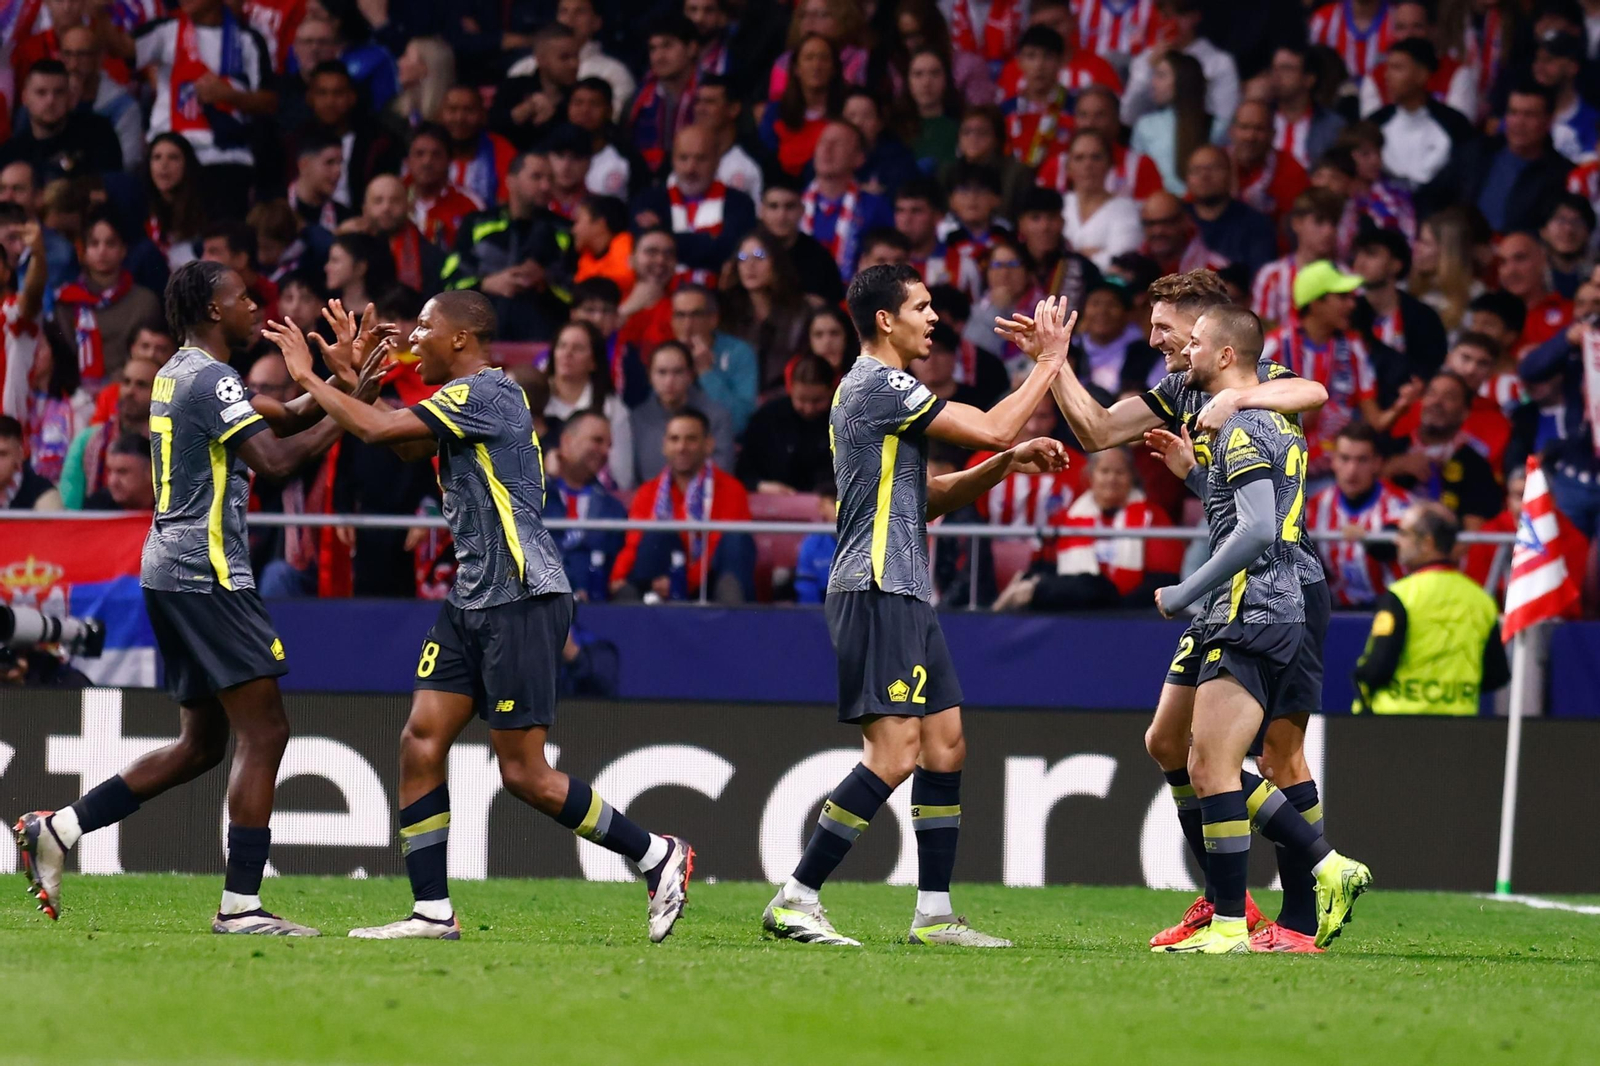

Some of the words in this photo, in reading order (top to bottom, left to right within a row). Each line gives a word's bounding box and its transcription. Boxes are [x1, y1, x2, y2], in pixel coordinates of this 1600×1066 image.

[149, 415, 173, 513] 7
[415, 640, 441, 678] 8
[912, 665, 927, 704] 2
[0, 687, 1325, 890] tercar
